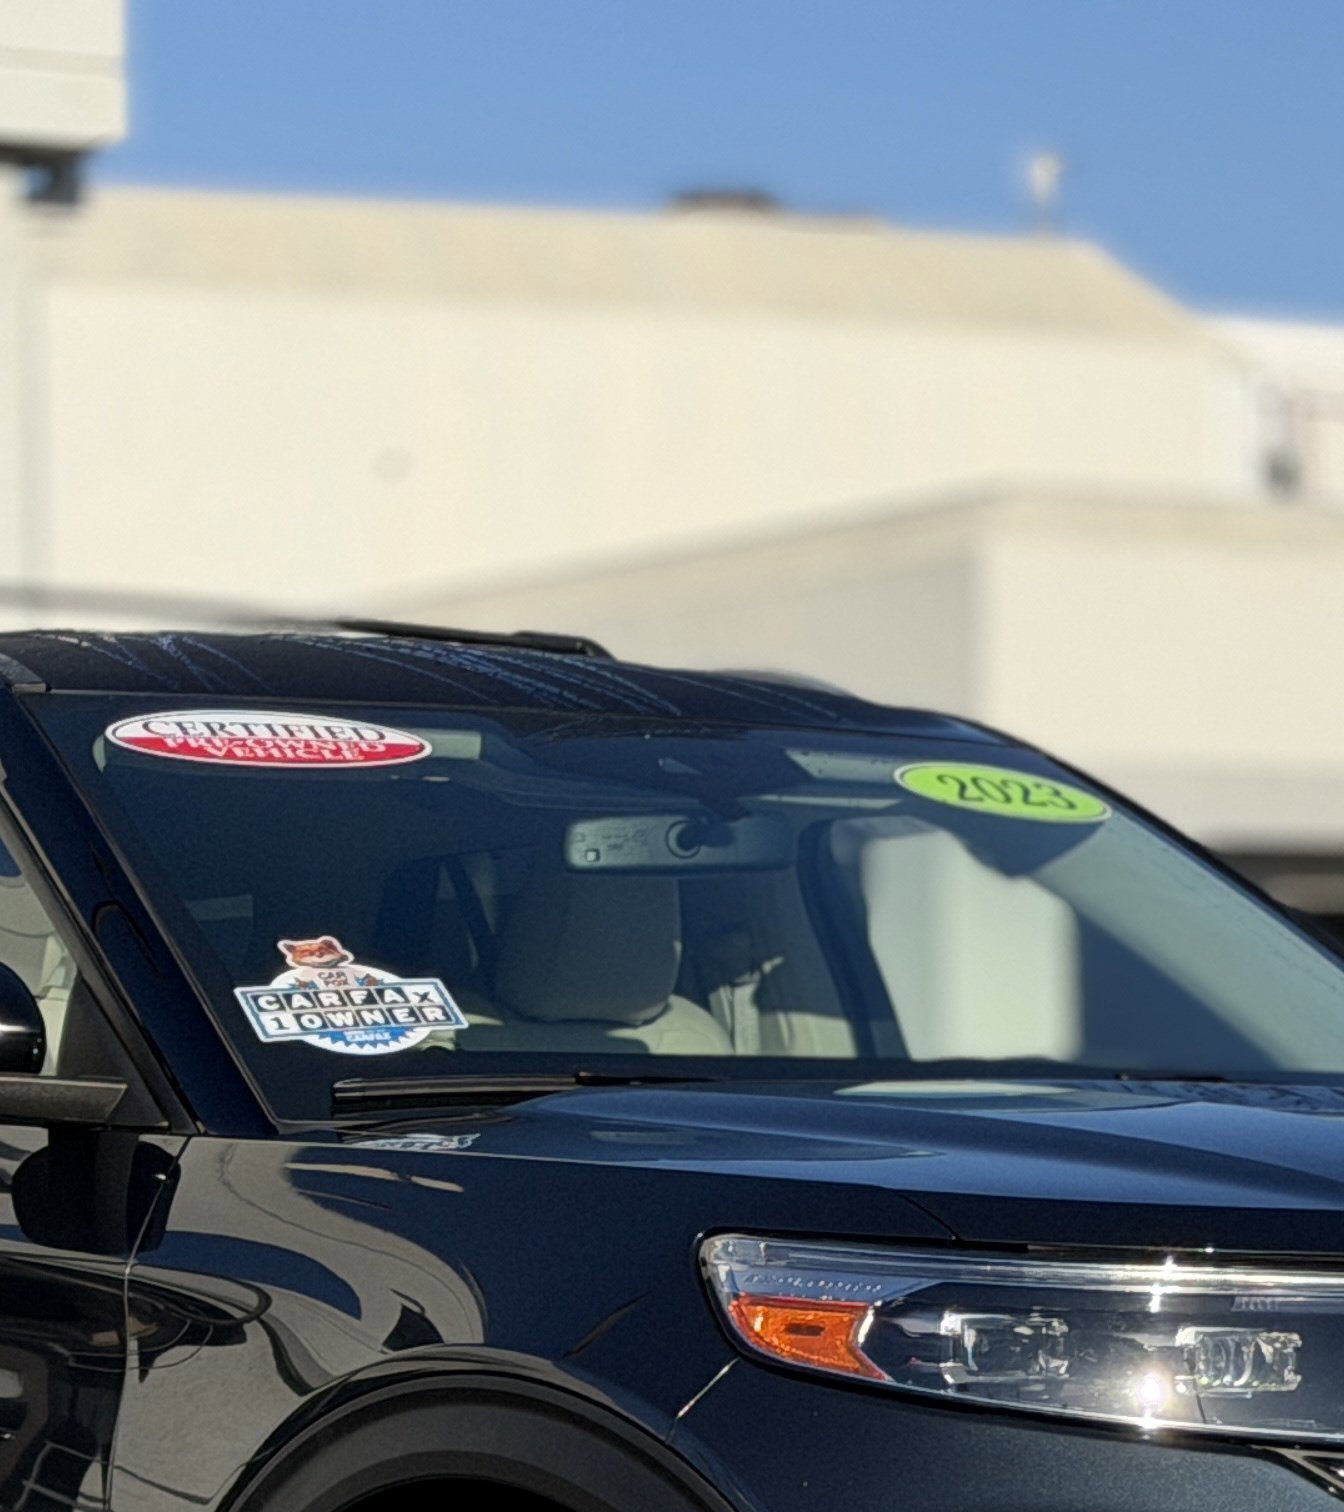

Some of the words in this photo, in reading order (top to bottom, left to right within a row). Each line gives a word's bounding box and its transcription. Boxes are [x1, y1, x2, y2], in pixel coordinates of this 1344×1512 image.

[142, 719, 386, 742] CERTIFIED
[160, 733, 387, 754] PRE-OWNED
[206, 745, 365, 761] VEHICLE
[936, 774, 1078, 810] 2023
[257, 988, 436, 1011] CARFAX
[267, 1015, 290, 1031] 1
[300, 1006, 446, 1030] OWNER
